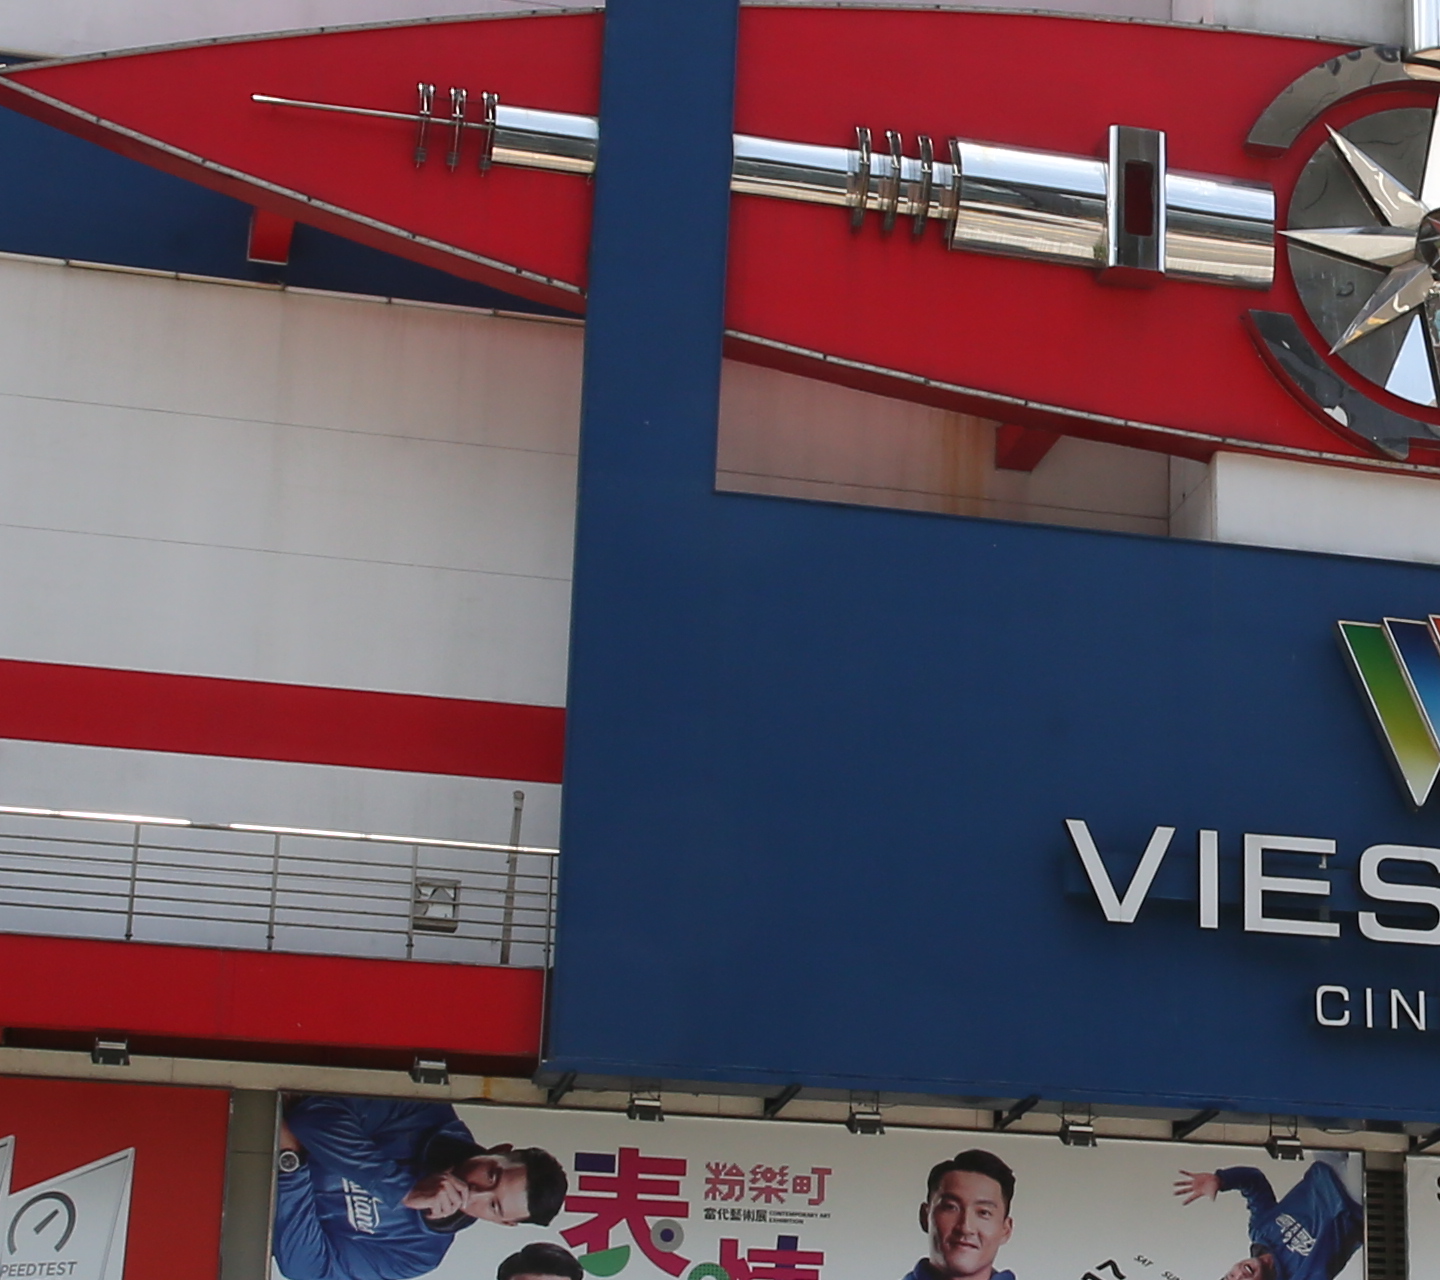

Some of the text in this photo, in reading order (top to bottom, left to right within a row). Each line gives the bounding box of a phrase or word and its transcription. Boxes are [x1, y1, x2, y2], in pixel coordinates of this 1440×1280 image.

[704, 1161, 833, 1206] 粉樂町
[0, 1261, 78, 1277] PEEDTEST
